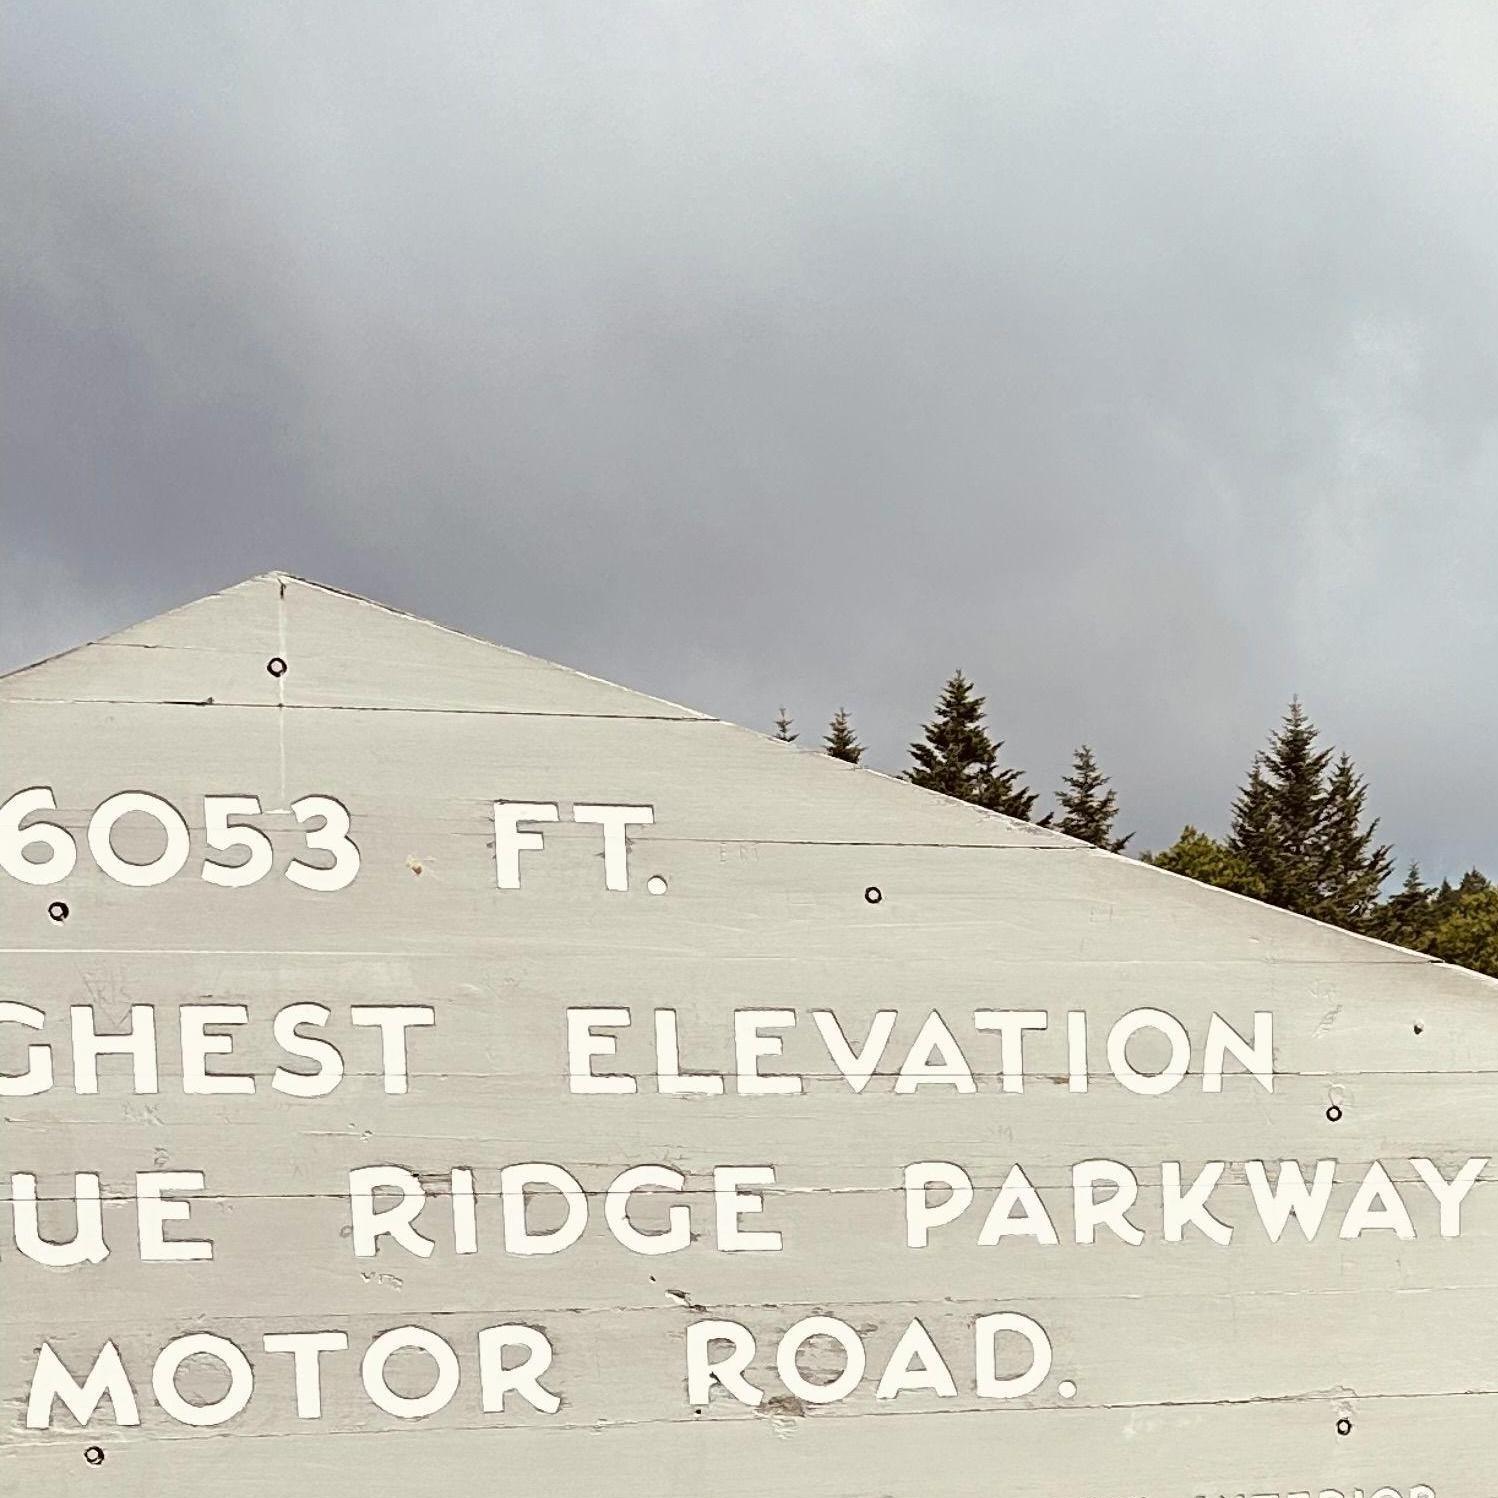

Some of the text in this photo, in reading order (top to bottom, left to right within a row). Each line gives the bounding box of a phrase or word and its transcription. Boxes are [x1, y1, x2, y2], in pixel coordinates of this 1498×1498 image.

[0, 786, 668, 895] 6053 FT.
[567, 1006, 1275, 1096] ELEVATION
[10, 1157, 1490, 1267] UE RIDGE PARKWAY
[26, 1313, 1077, 1428] MOTOR ROAD.
